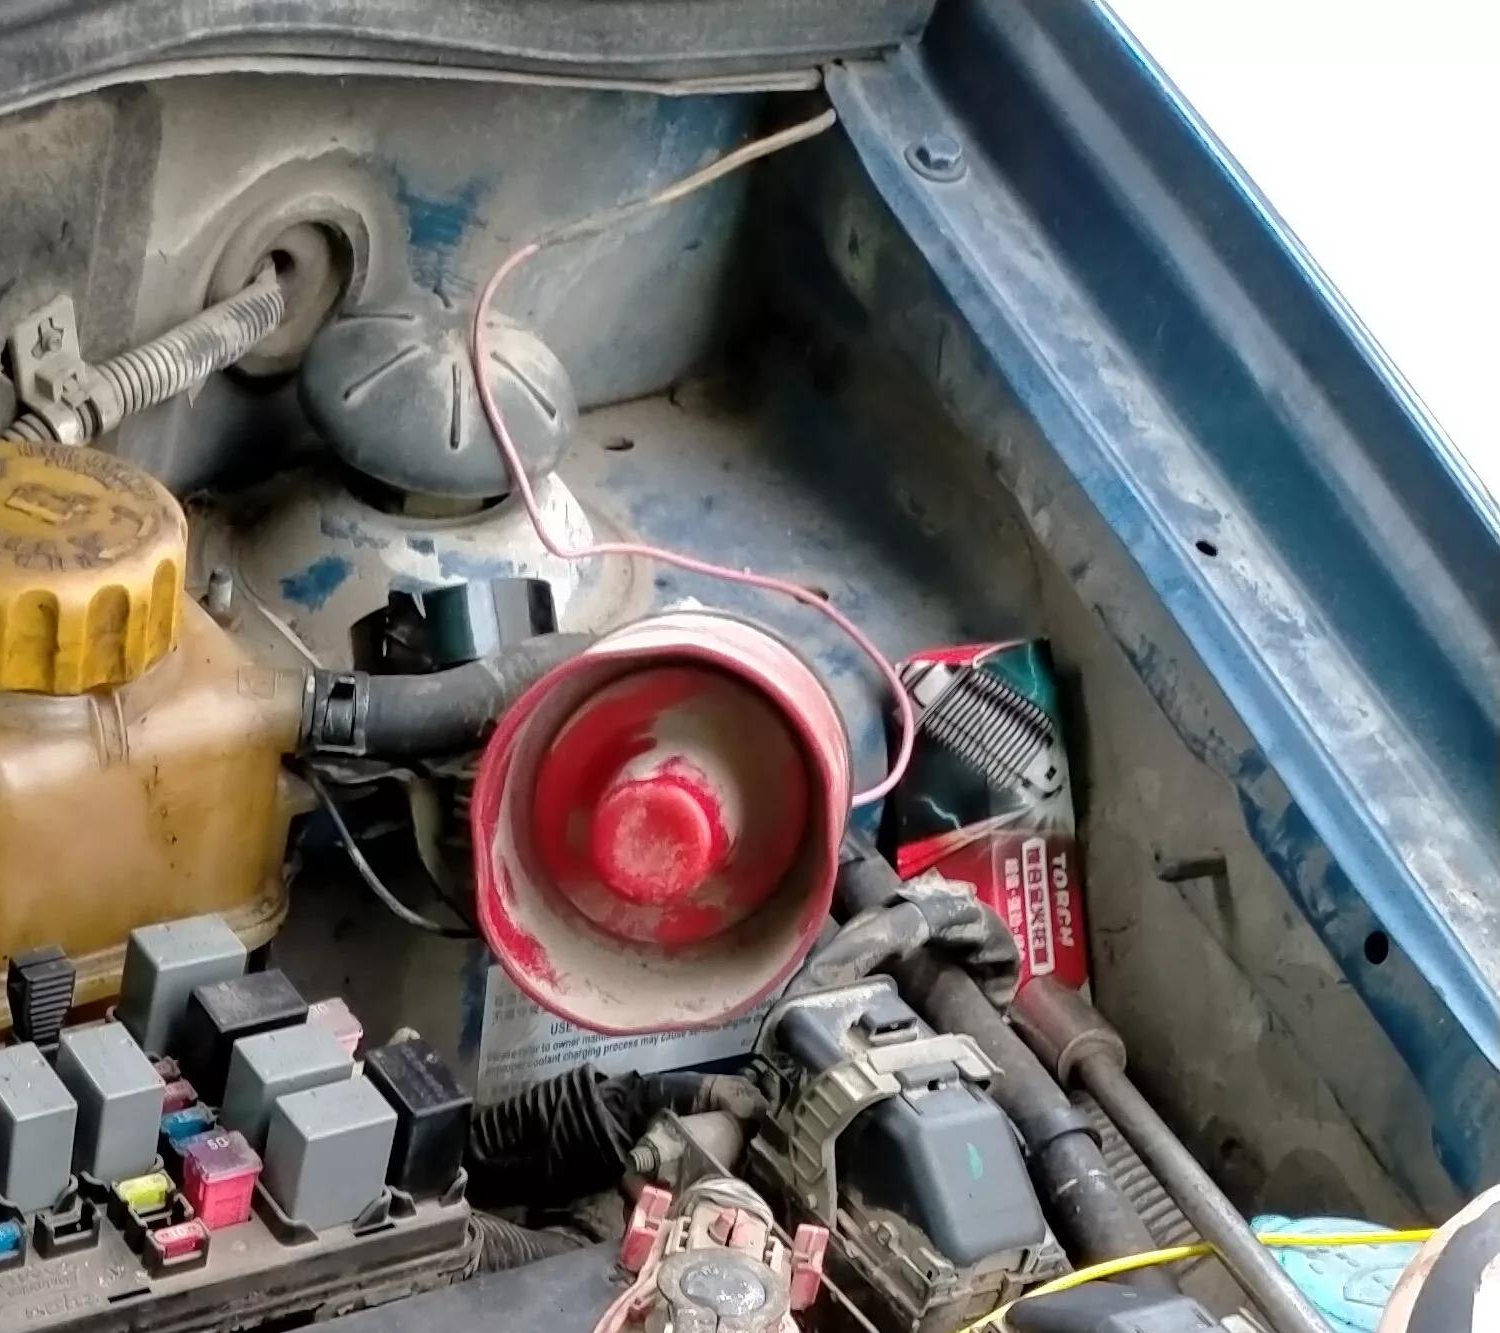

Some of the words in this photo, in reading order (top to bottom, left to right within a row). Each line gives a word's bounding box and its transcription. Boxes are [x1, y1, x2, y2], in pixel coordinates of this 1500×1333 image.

[1051, 852, 1075, 948] TORCH
[552, 1038, 580, 1051] owner
[563, 1046, 602, 1062] charging
[603, 1039, 638, 1056] process
[641, 1035, 658, 1048] may
[206, 1137, 229, 1150] 50
